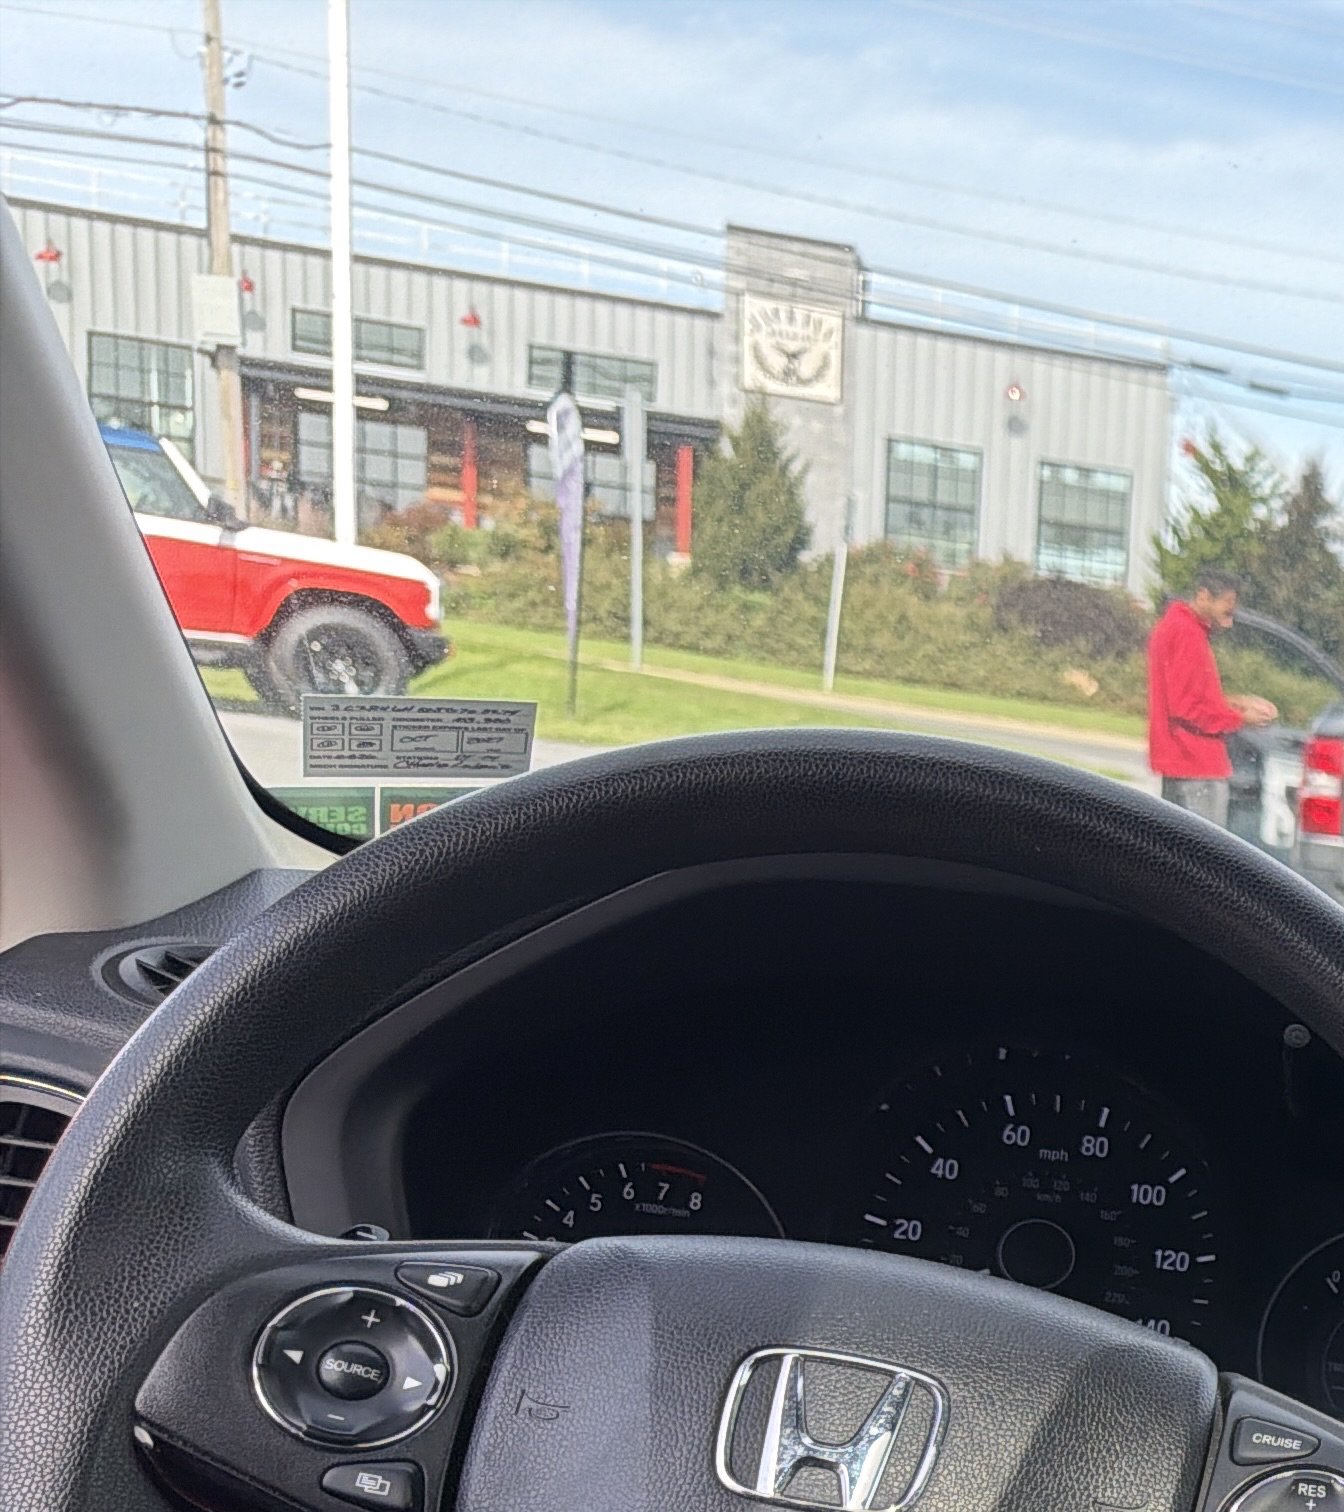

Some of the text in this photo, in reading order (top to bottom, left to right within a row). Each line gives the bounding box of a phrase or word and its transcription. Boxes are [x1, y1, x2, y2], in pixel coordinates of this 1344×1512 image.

[399, 734, 438, 743] OCT
[1002, 1125, 1031, 1147] 60
[1038, 1148, 1069, 1163] mph
[1081, 1136, 1109, 1158] 80
[930, 1158, 959, 1180] 40
[622, 1181, 635, 1200] 6
[658, 1182, 670, 1201] 7
[1130, 1183, 1166, 1207] 100
[589, 1193, 602, 1212] 5
[688, 1191, 703, 1211] 8
[562, 1209, 575, 1228] 4
[893, 1219, 923, 1242] 20
[1154, 1248, 1190, 1272] 120
[1331, 1269, 1341, 1283] 0
[323, 1358, 382, 1382] SOURCE
[1252, 1432, 1302, 1450] CRUISE
[1297, 1482, 1327, 1498] RES
